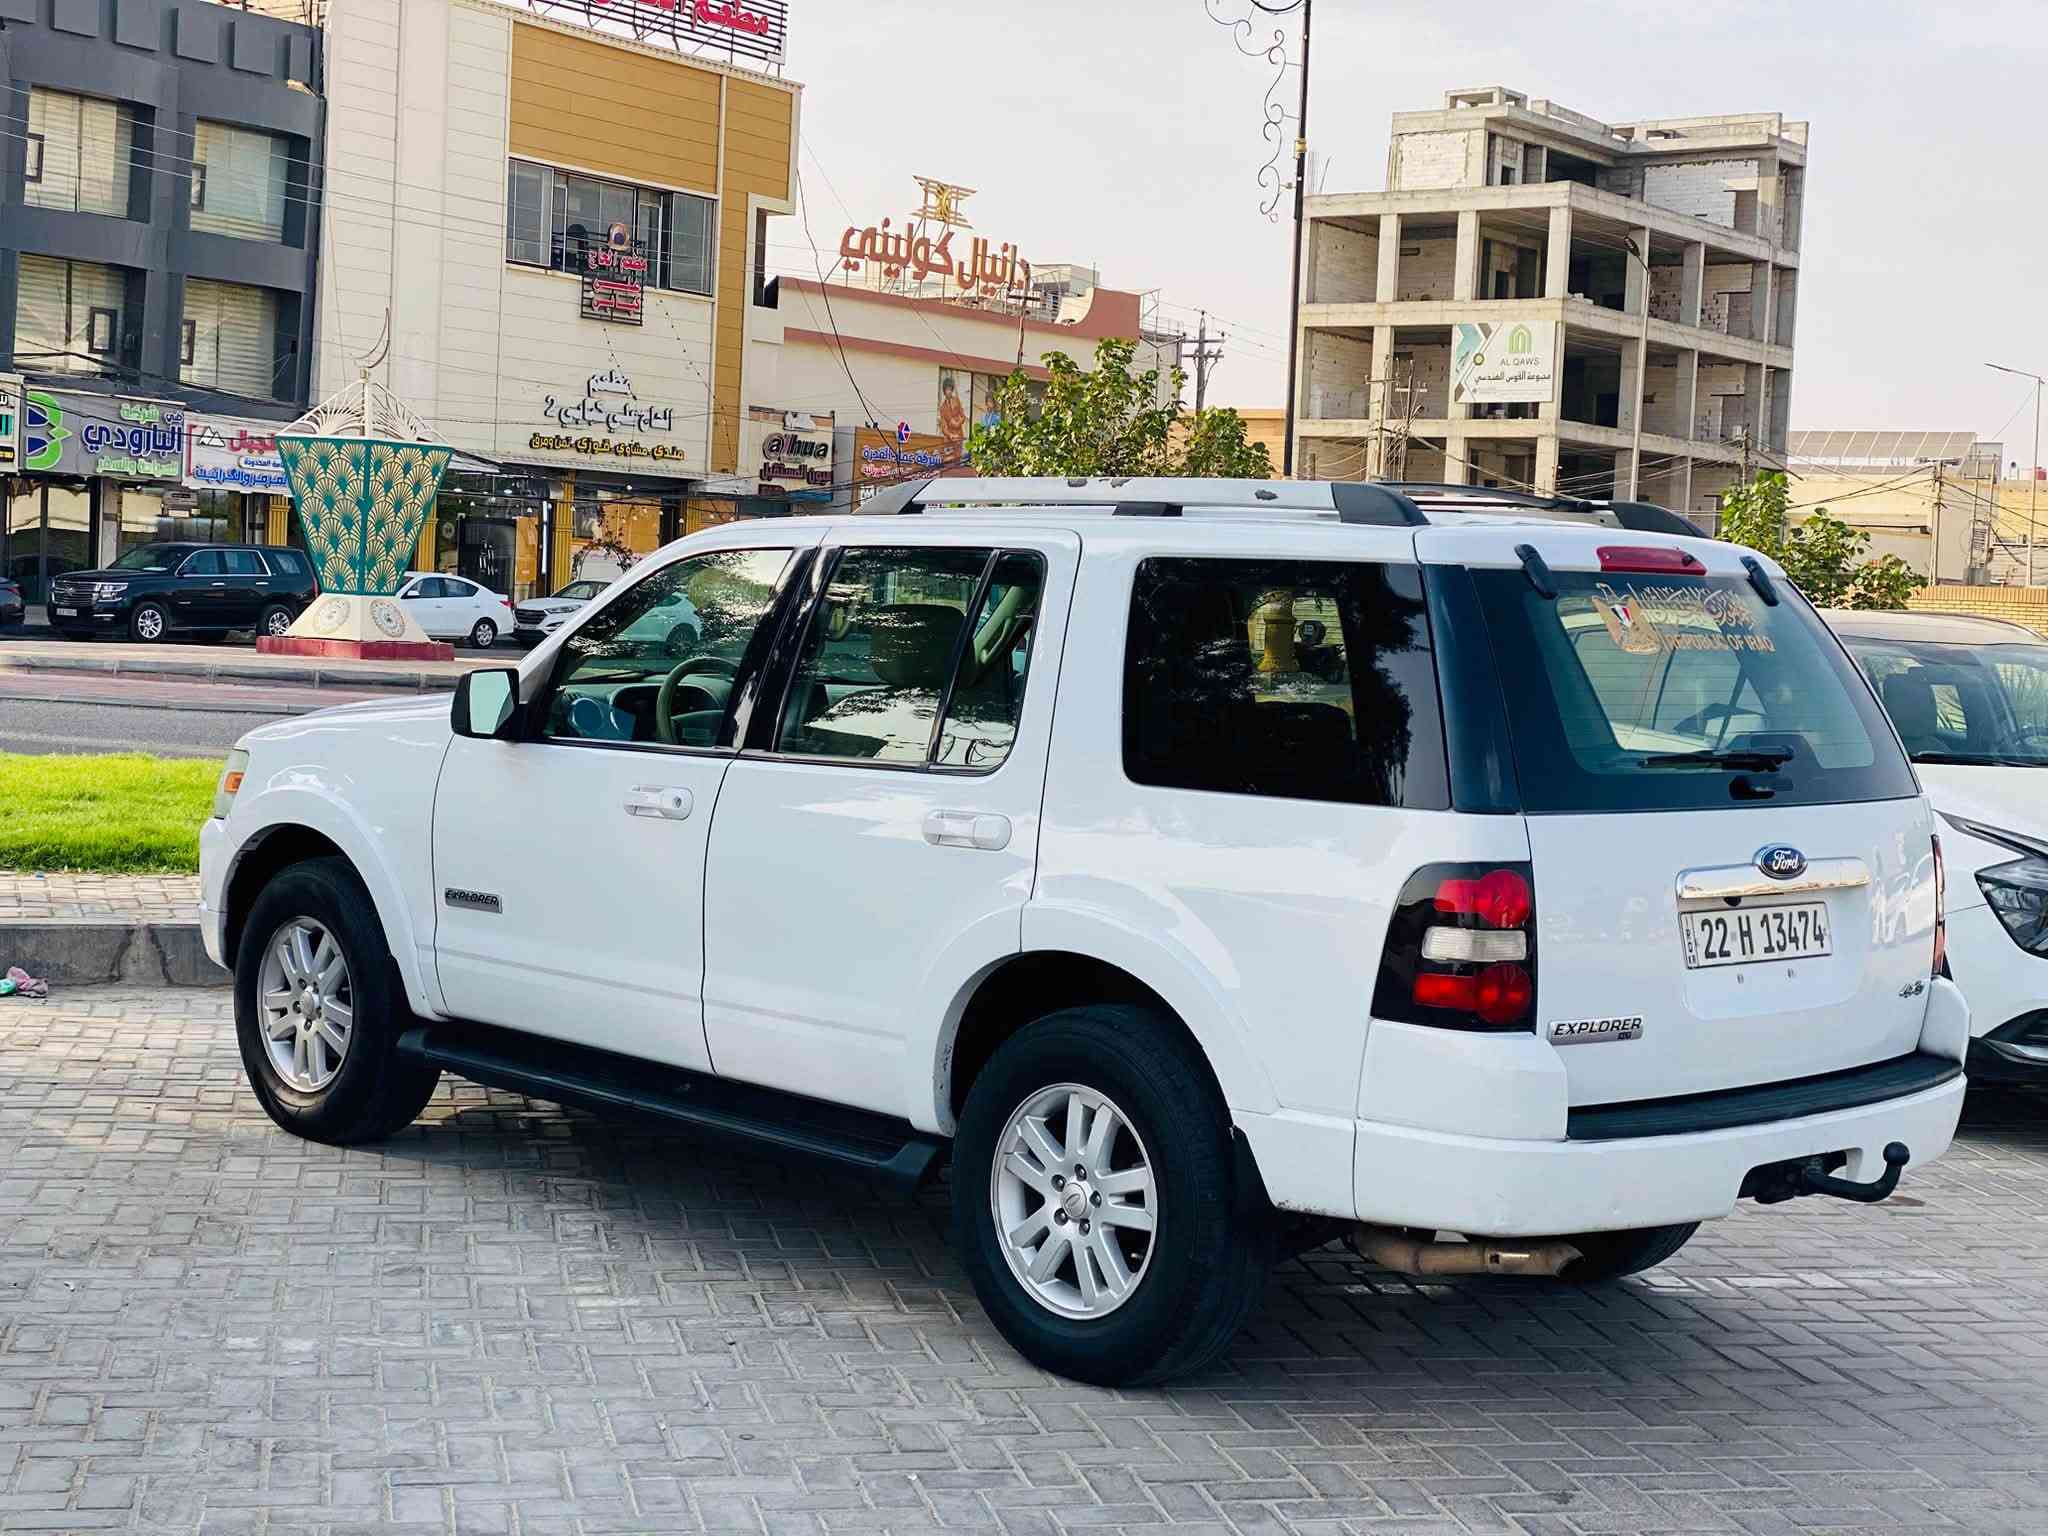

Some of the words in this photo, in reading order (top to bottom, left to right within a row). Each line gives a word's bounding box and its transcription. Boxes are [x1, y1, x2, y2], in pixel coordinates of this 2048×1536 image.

[543, 394, 559, 418] 2
[83, 422, 183, 458] البارودي
[1773, 850, 1799, 871] Ford
[445, 889, 499, 905] EXPLORER
[1701, 917, 1731, 959] 22
[1738, 914, 1754, 956] H
[1760, 909, 1824, 954] 13474
[1554, 1017, 1642, 1036] EXPLORER
